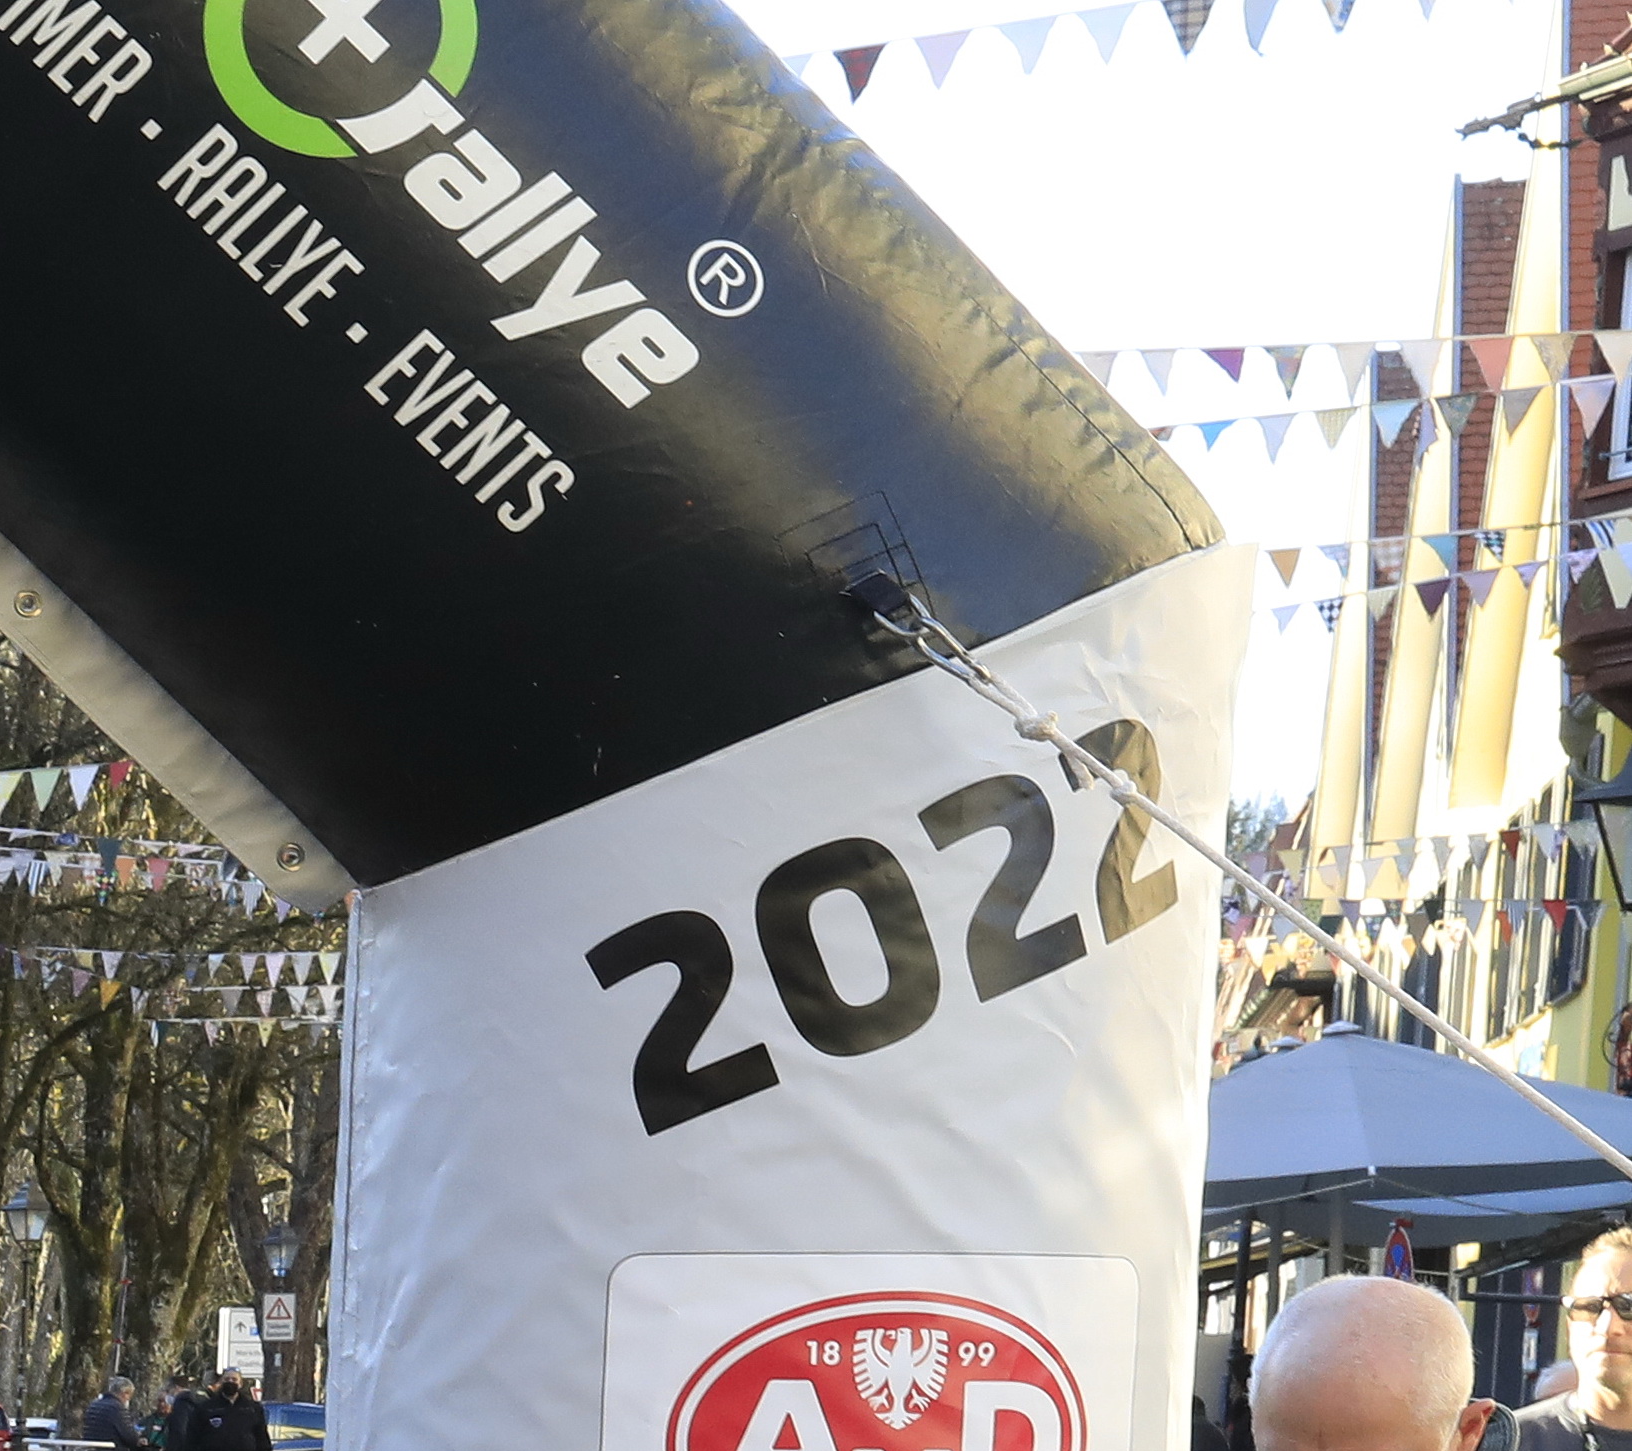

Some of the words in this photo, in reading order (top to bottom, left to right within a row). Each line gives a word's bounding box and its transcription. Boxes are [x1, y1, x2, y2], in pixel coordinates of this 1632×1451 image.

[157, 123, 365, 327] RALLYE
[364, 329, 576, 533] EVENTS
[335, 78, 700, 409] rallye
[583, 718, 1179, 1136] 2022
[805, 1339, 841, 1367] 18
[957, 1341, 996, 1368] 99
